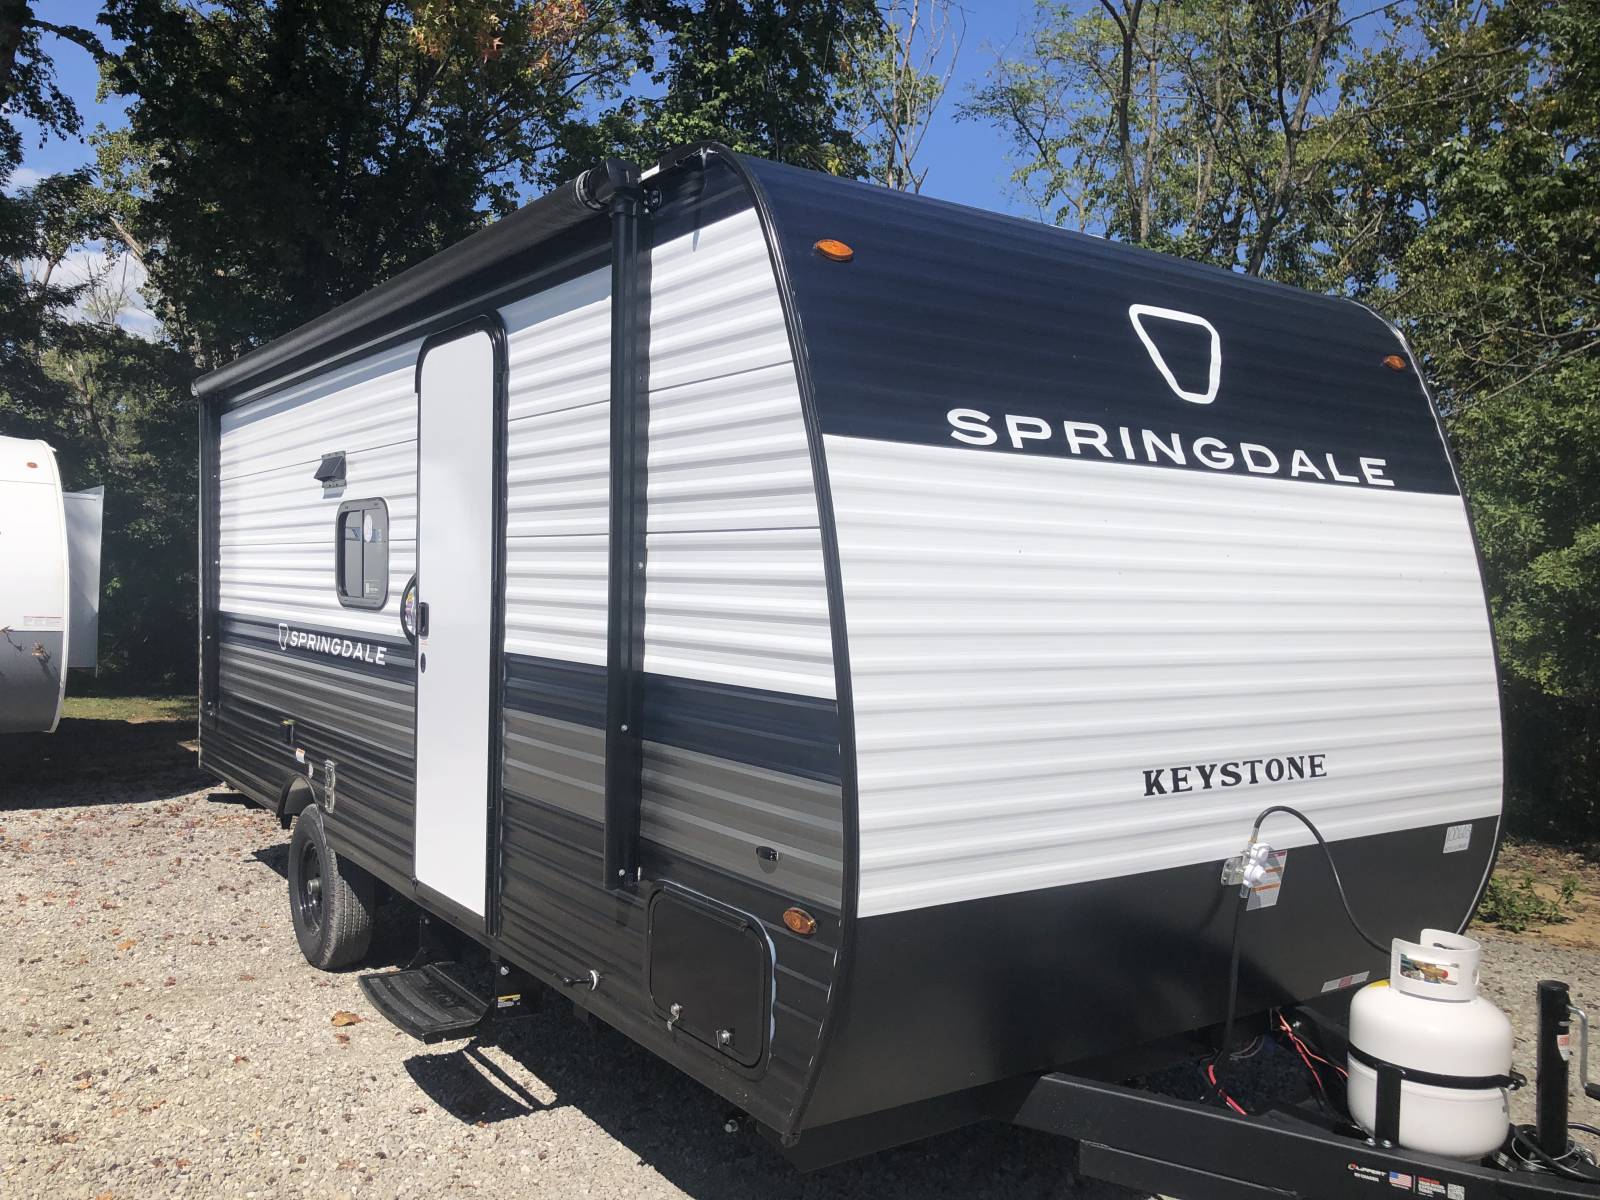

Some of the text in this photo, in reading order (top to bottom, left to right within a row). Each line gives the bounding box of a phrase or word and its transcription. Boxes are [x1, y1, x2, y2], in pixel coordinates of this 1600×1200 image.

[946, 408, 1395, 487] SPRINGDALE
[289, 631, 387, 666] SPRINGDALE
[1142, 754, 1327, 796] KEYSTONE
